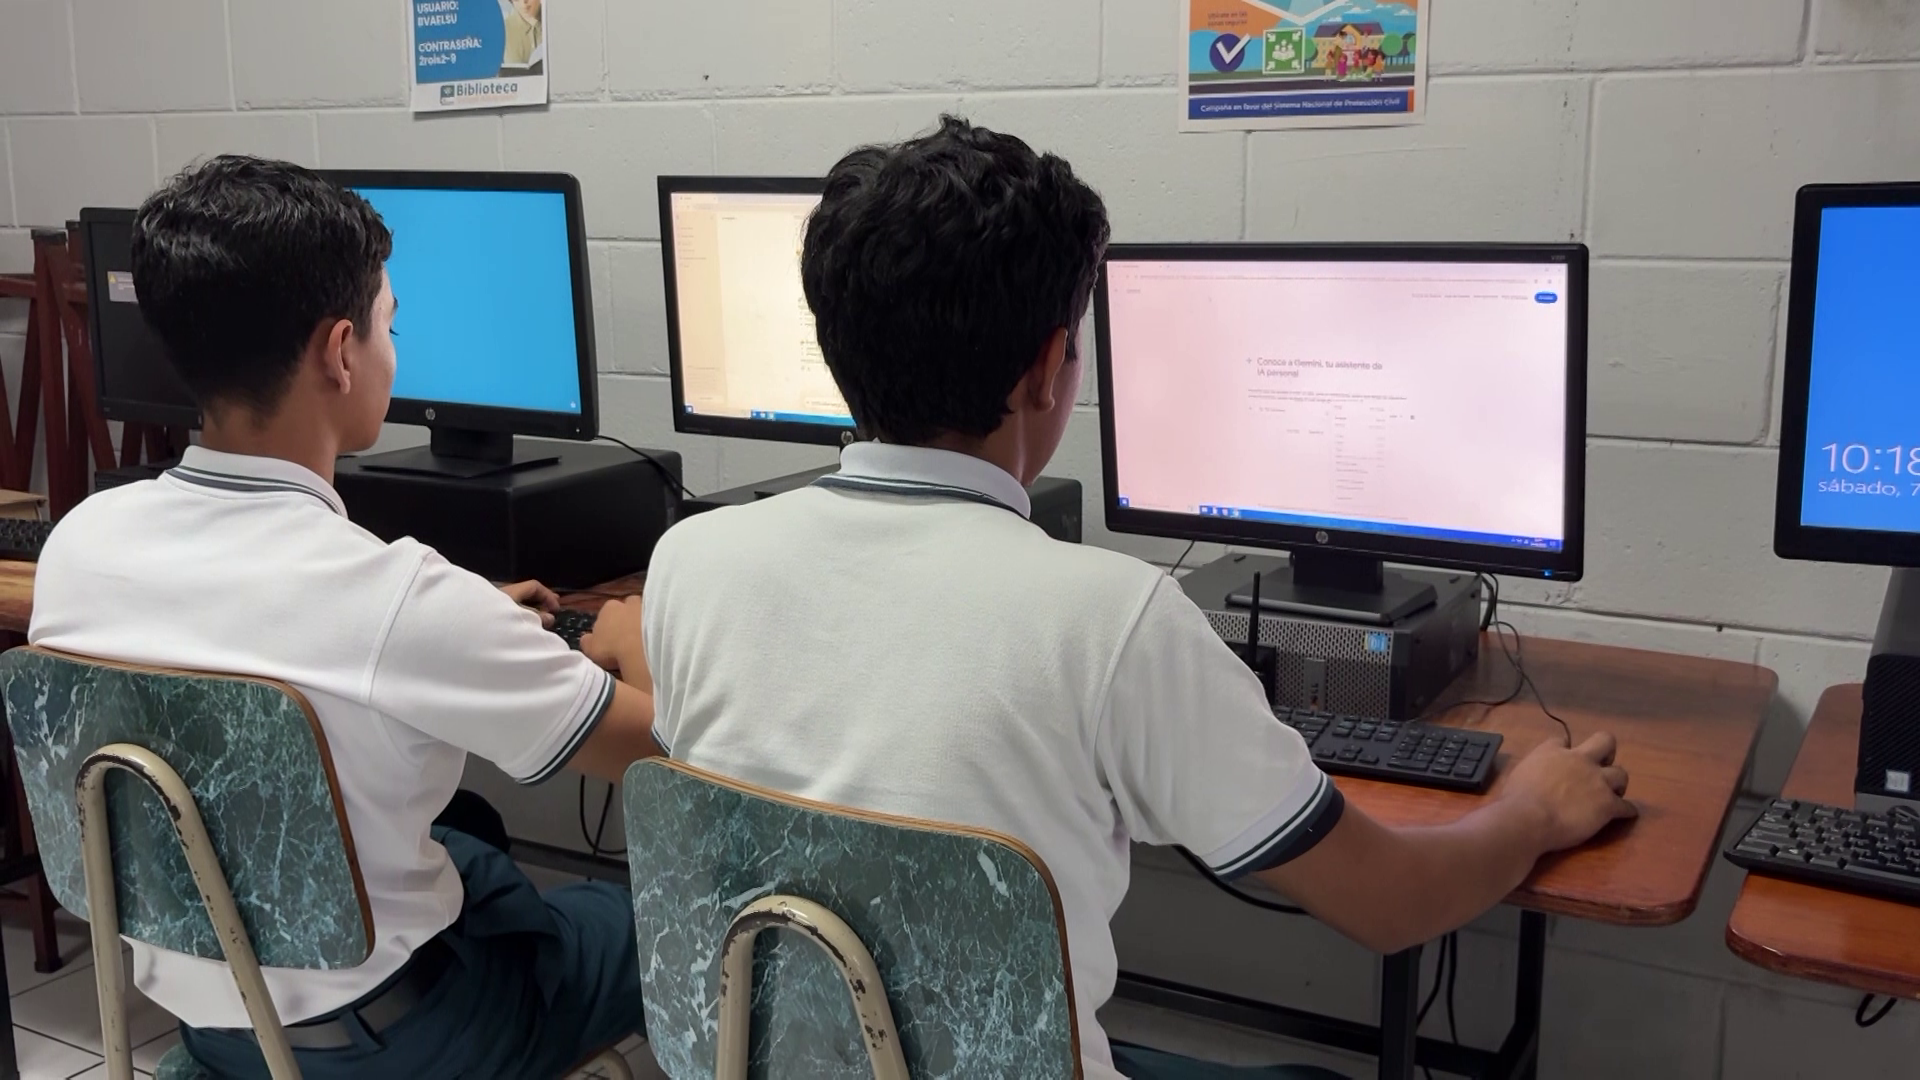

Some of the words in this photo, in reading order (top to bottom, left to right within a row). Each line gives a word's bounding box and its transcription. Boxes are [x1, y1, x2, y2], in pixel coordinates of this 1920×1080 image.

[417, 1, 459, 14] USUARIO:
[418, 36, 483, 52] CONTRASEÑA:
[456, 82, 518, 96] Biblioteca
[1200, 103, 1232, 113] Campaña
[1261, 101, 1272, 110] del
[1273, 101, 1301, 109] Sistema
[1302, 100, 1333, 108] Nacional
[1333, 99, 1343, 107] de
[1383, 97, 1400, 106] Civil
[1257, 357, 1287, 366] Conoce
[1325, 360, 1334, 369] tu
[1335, 360, 1370, 370] asistente
[1372, 361, 1383, 370] de
[1257, 368, 1265, 376] IA
[1266, 369, 1299, 378] personal
[1818, 479, 1901, 498] sábado,
